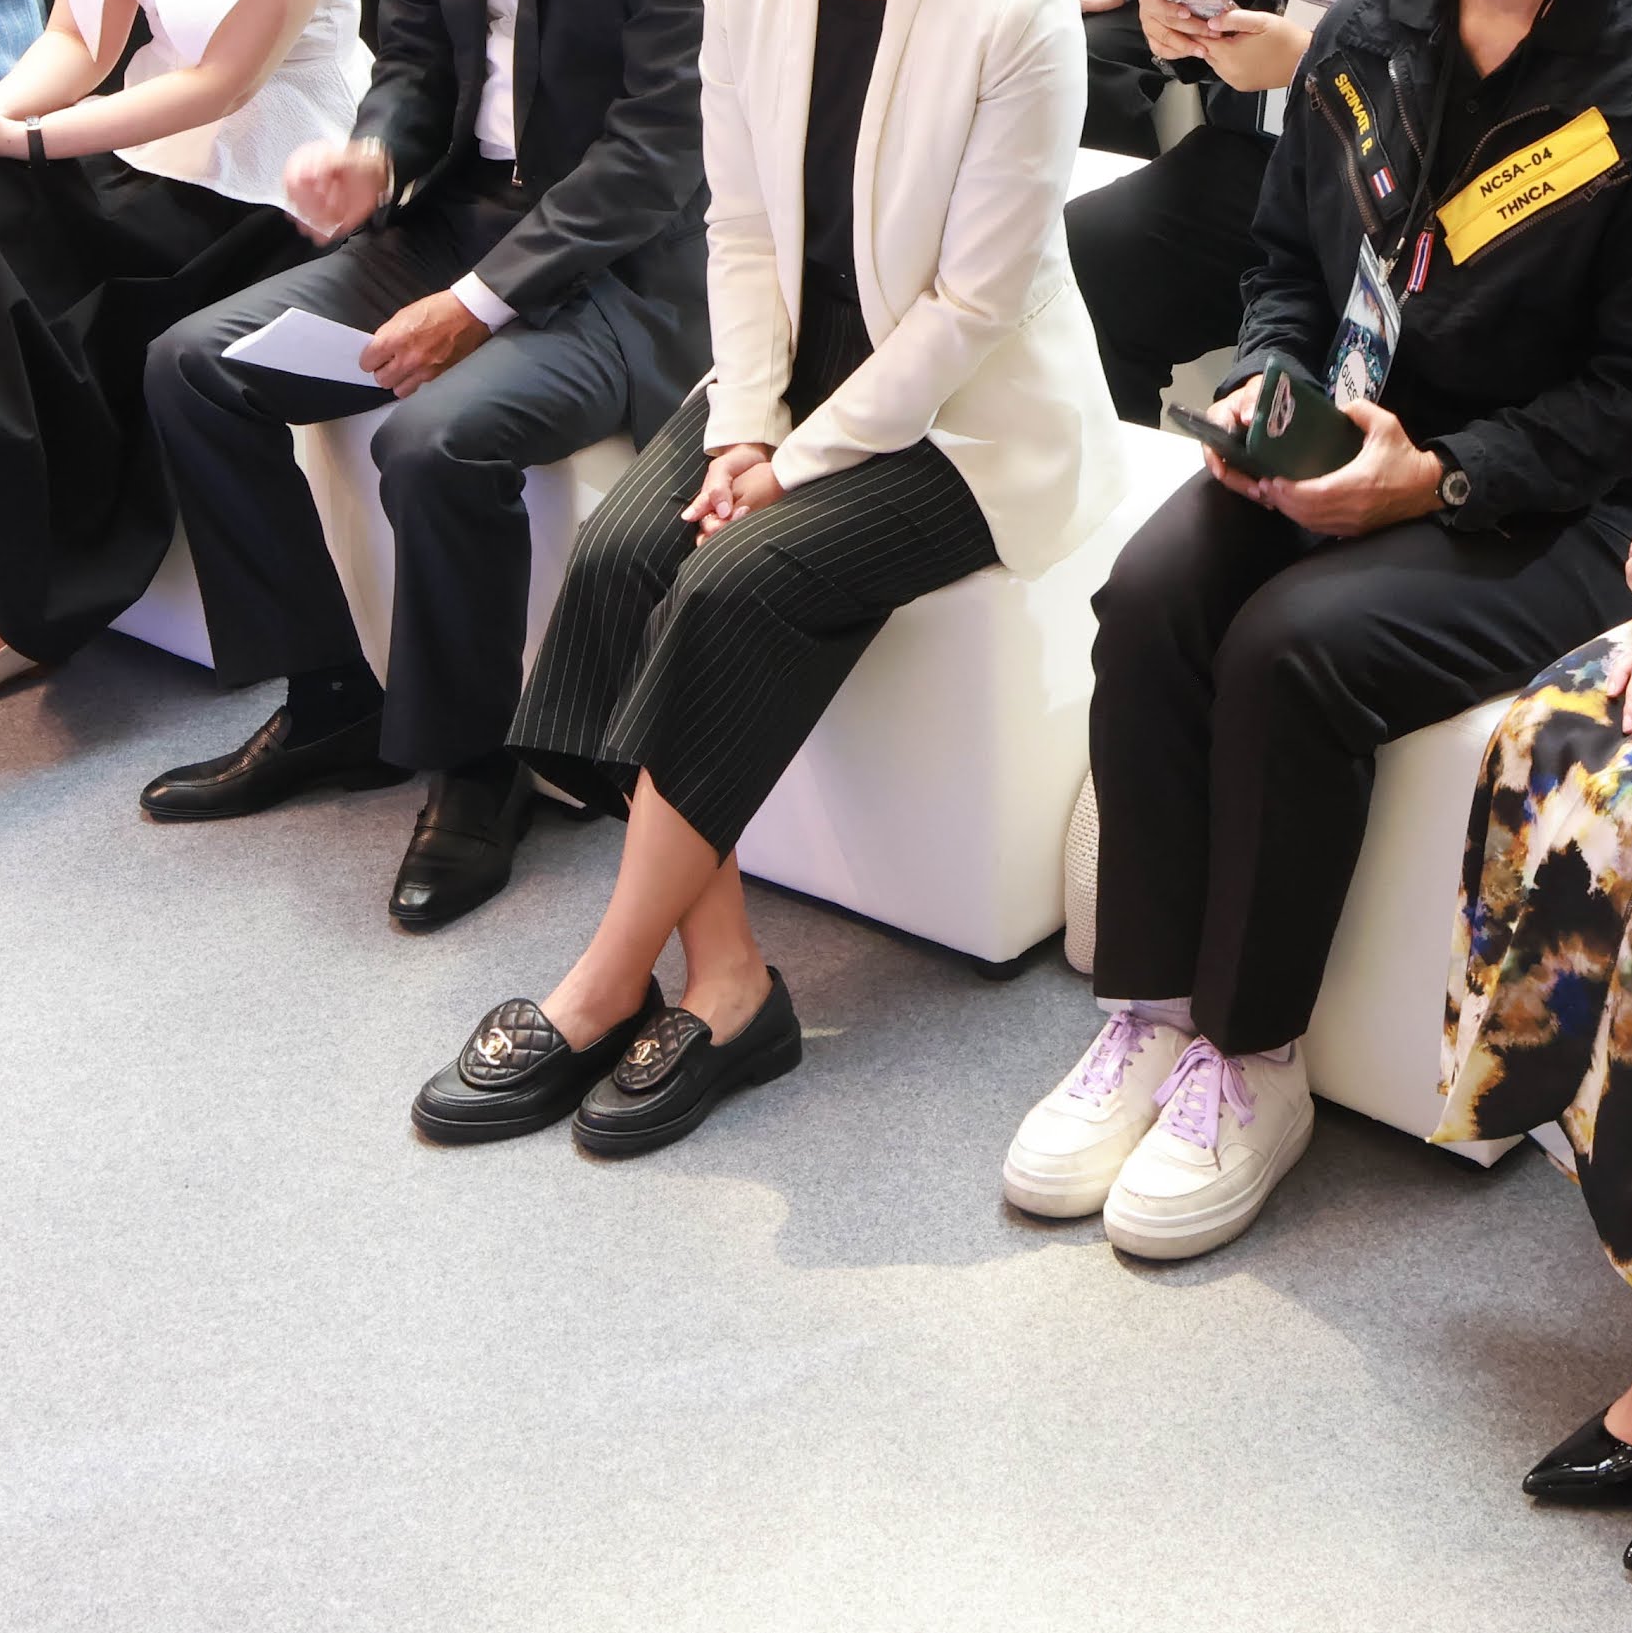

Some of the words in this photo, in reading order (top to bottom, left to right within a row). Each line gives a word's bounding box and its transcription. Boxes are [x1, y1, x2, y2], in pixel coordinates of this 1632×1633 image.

[1334, 73, 1370, 135] SIRINATE
[1479, 147, 1553, 198] NCSA-04
[1496, 181, 1556, 220] THNCA
[1341, 364, 1360, 402] GUES
